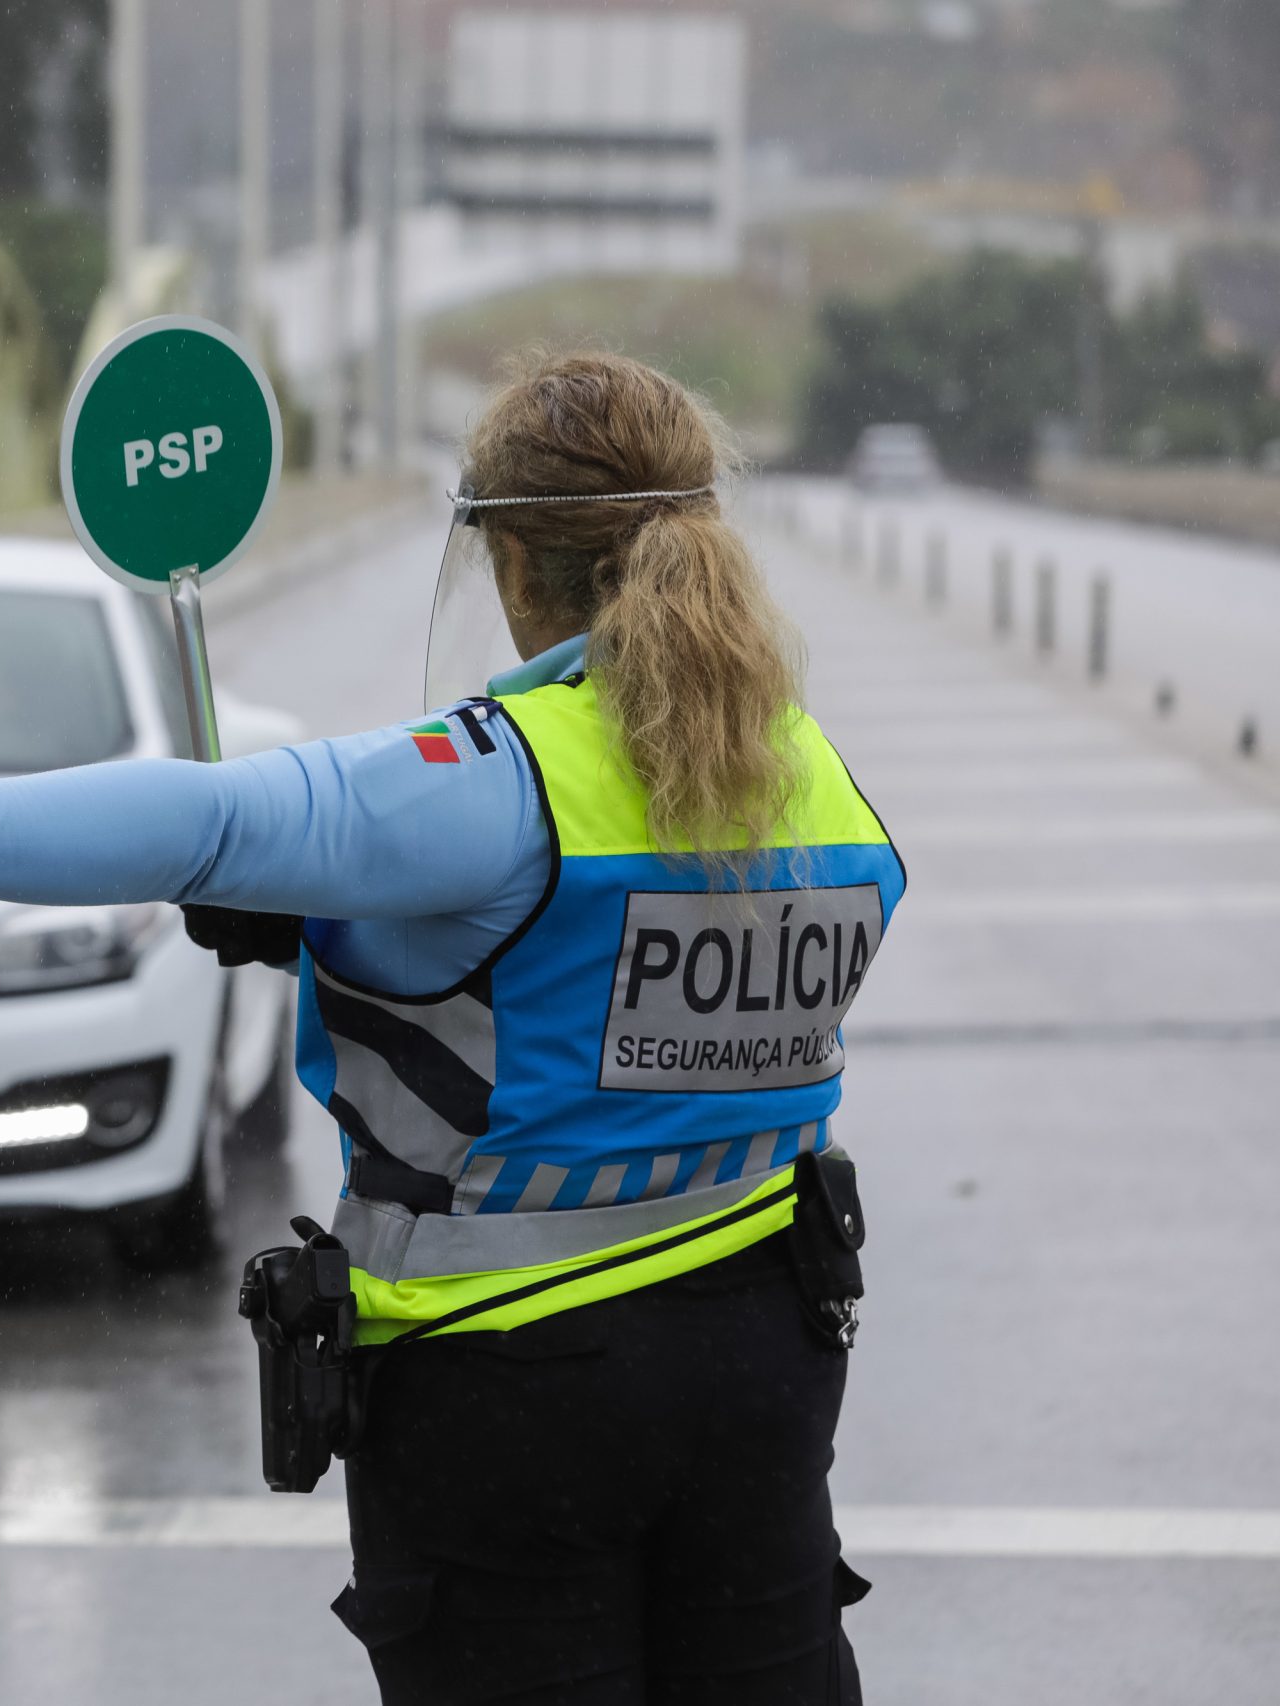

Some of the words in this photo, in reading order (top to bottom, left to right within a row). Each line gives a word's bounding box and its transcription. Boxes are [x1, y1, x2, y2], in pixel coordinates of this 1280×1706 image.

[123, 425, 224, 487] PSP
[623, 903, 869, 1014] POLÍCIA
[615, 1035, 782, 1077] SEGURANÇA
